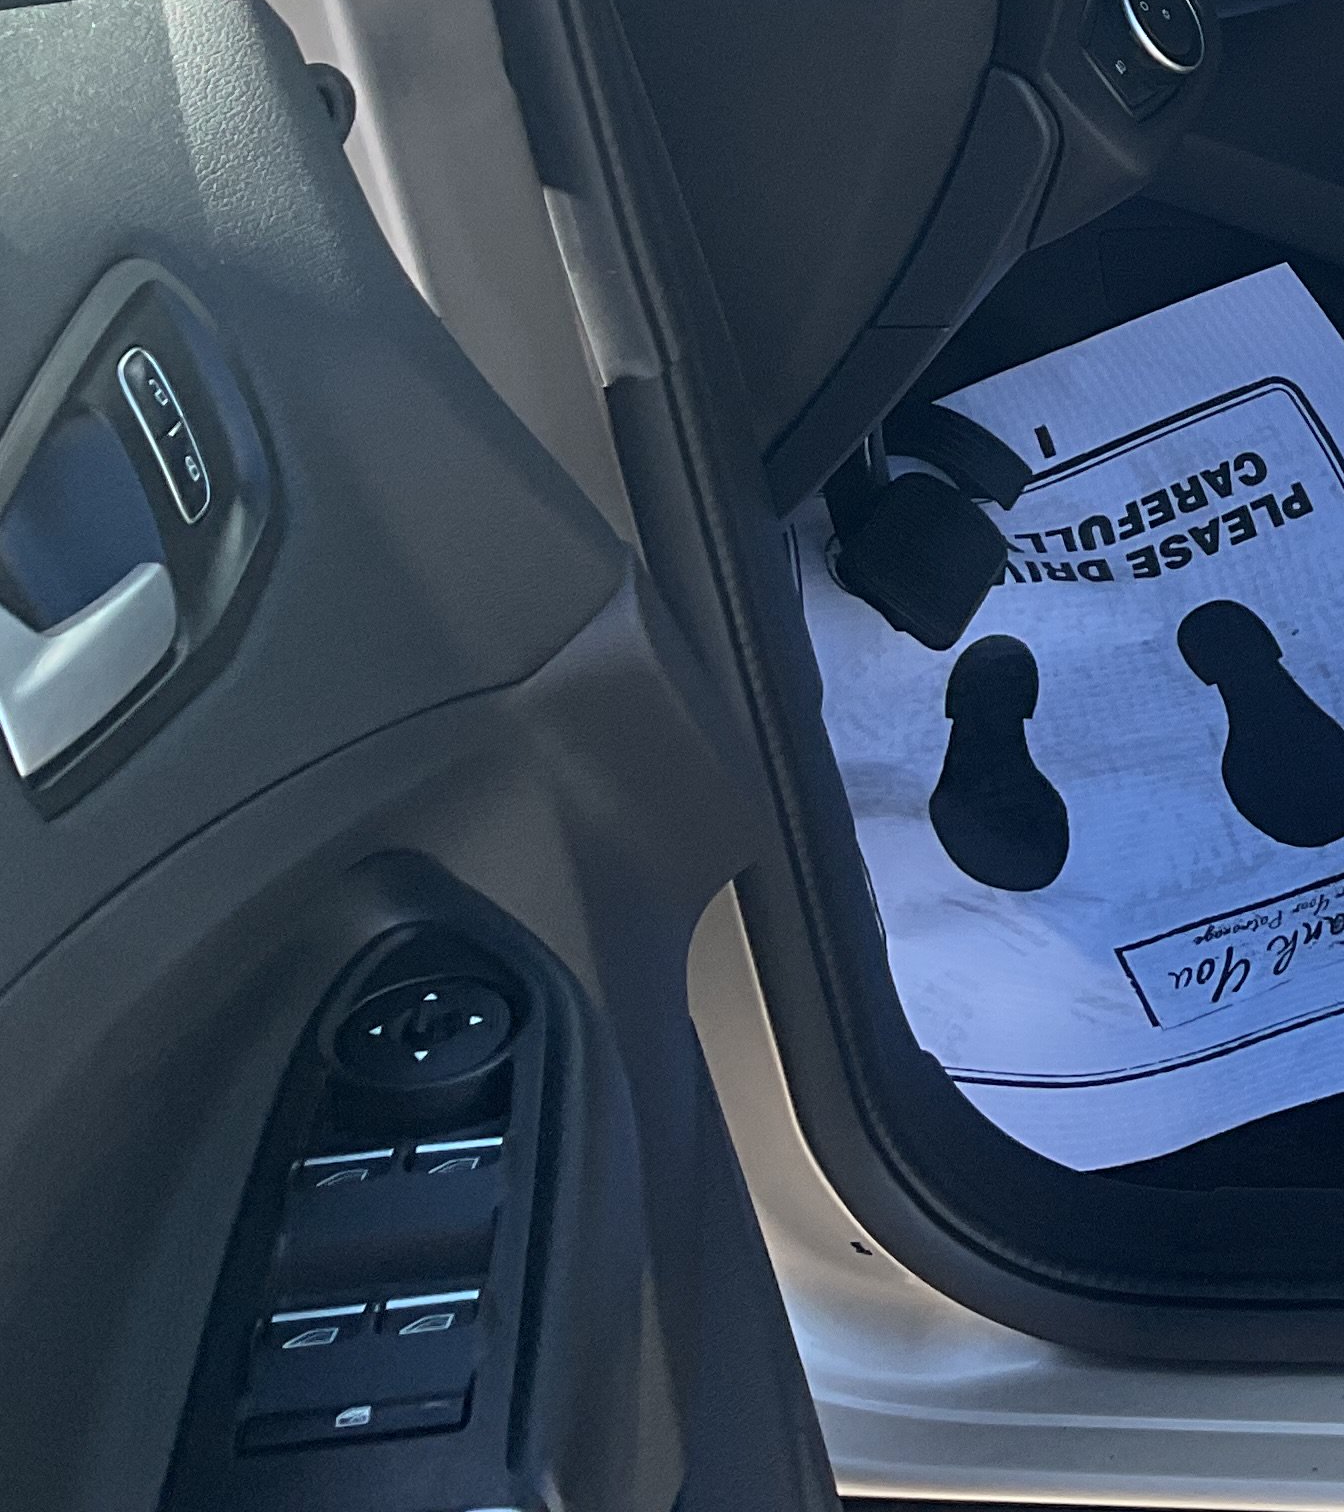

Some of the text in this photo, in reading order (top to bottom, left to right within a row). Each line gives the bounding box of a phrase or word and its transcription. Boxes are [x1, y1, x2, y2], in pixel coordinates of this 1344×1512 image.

[1004, 482, 1313, 584] PLEASE DRIV
[1192, 910, 1283, 946] Patronage
[1292, 893, 1330, 917] Your
[1167, 945, 1251, 1003] You
